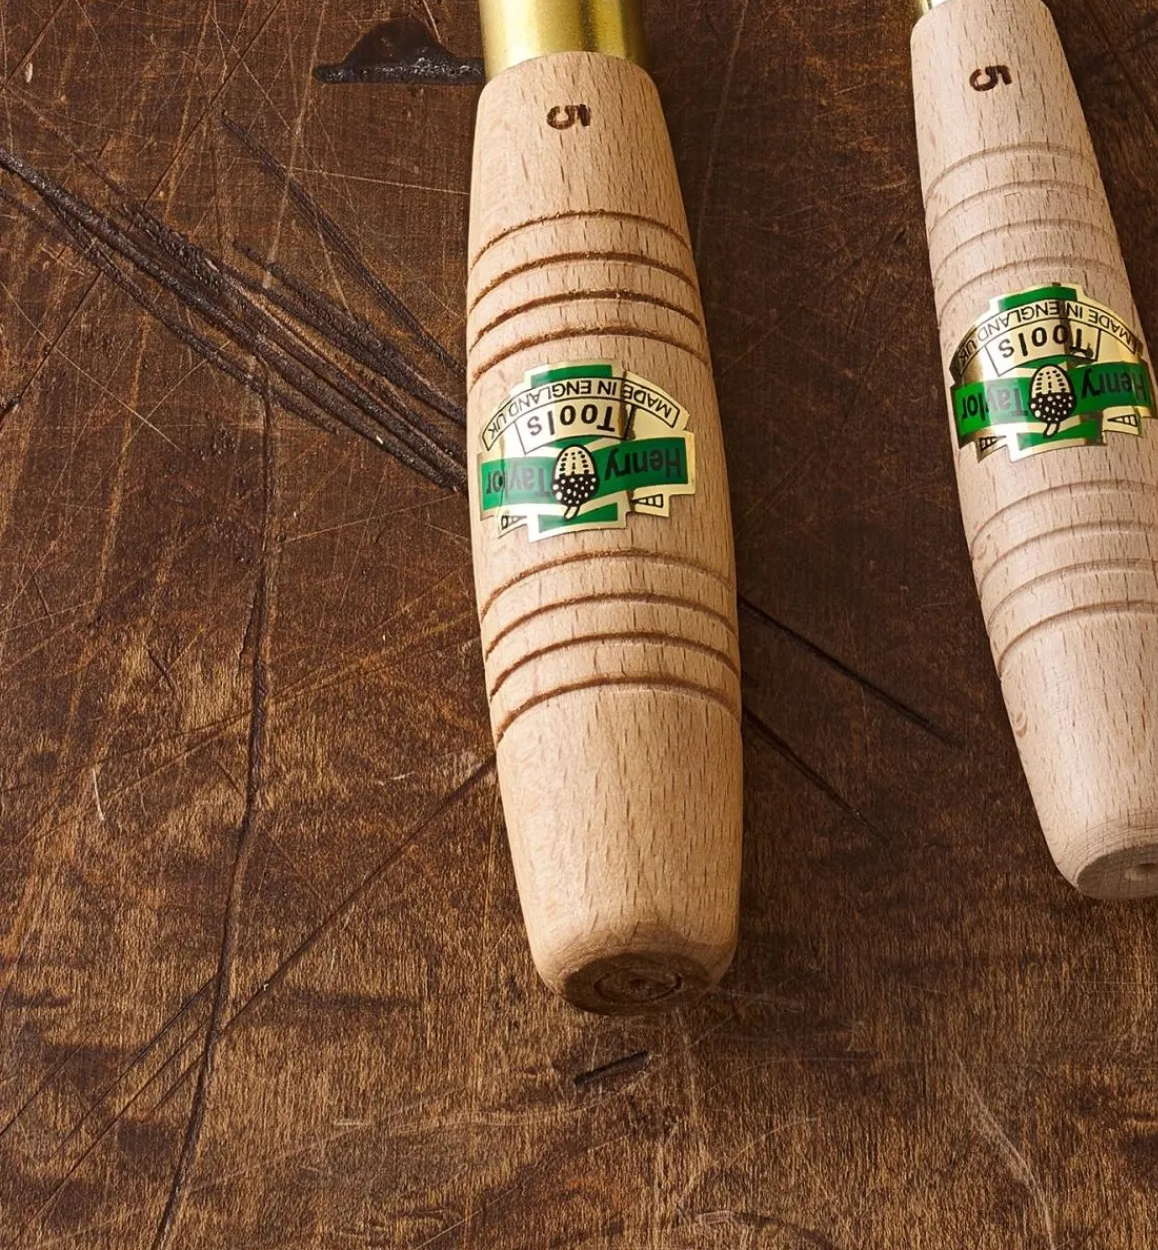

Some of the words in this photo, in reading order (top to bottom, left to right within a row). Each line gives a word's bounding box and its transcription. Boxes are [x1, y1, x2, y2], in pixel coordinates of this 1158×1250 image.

[969, 65, 1012, 91] 5
[546, 103, 591, 130] 5
[976, 300, 1061, 342] ENGLAND
[1065, 302, 1085, 319] IN
[997, 324, 1094, 359] Tools
[1087, 310, 1134, 346] MADE
[958, 338, 978, 365] UK
[508, 379, 592, 417] ENGLAND
[597, 380, 617, 395] IN
[621, 383, 674, 419] MADE
[961, 383, 1028, 421] Taylor
[1080, 369, 1149, 402] Henry
[487, 415, 509, 440] UK
[526, 404, 616, 436] Tools
[485, 460, 550, 497] Taylor
[604, 447, 683, 481] Henry
